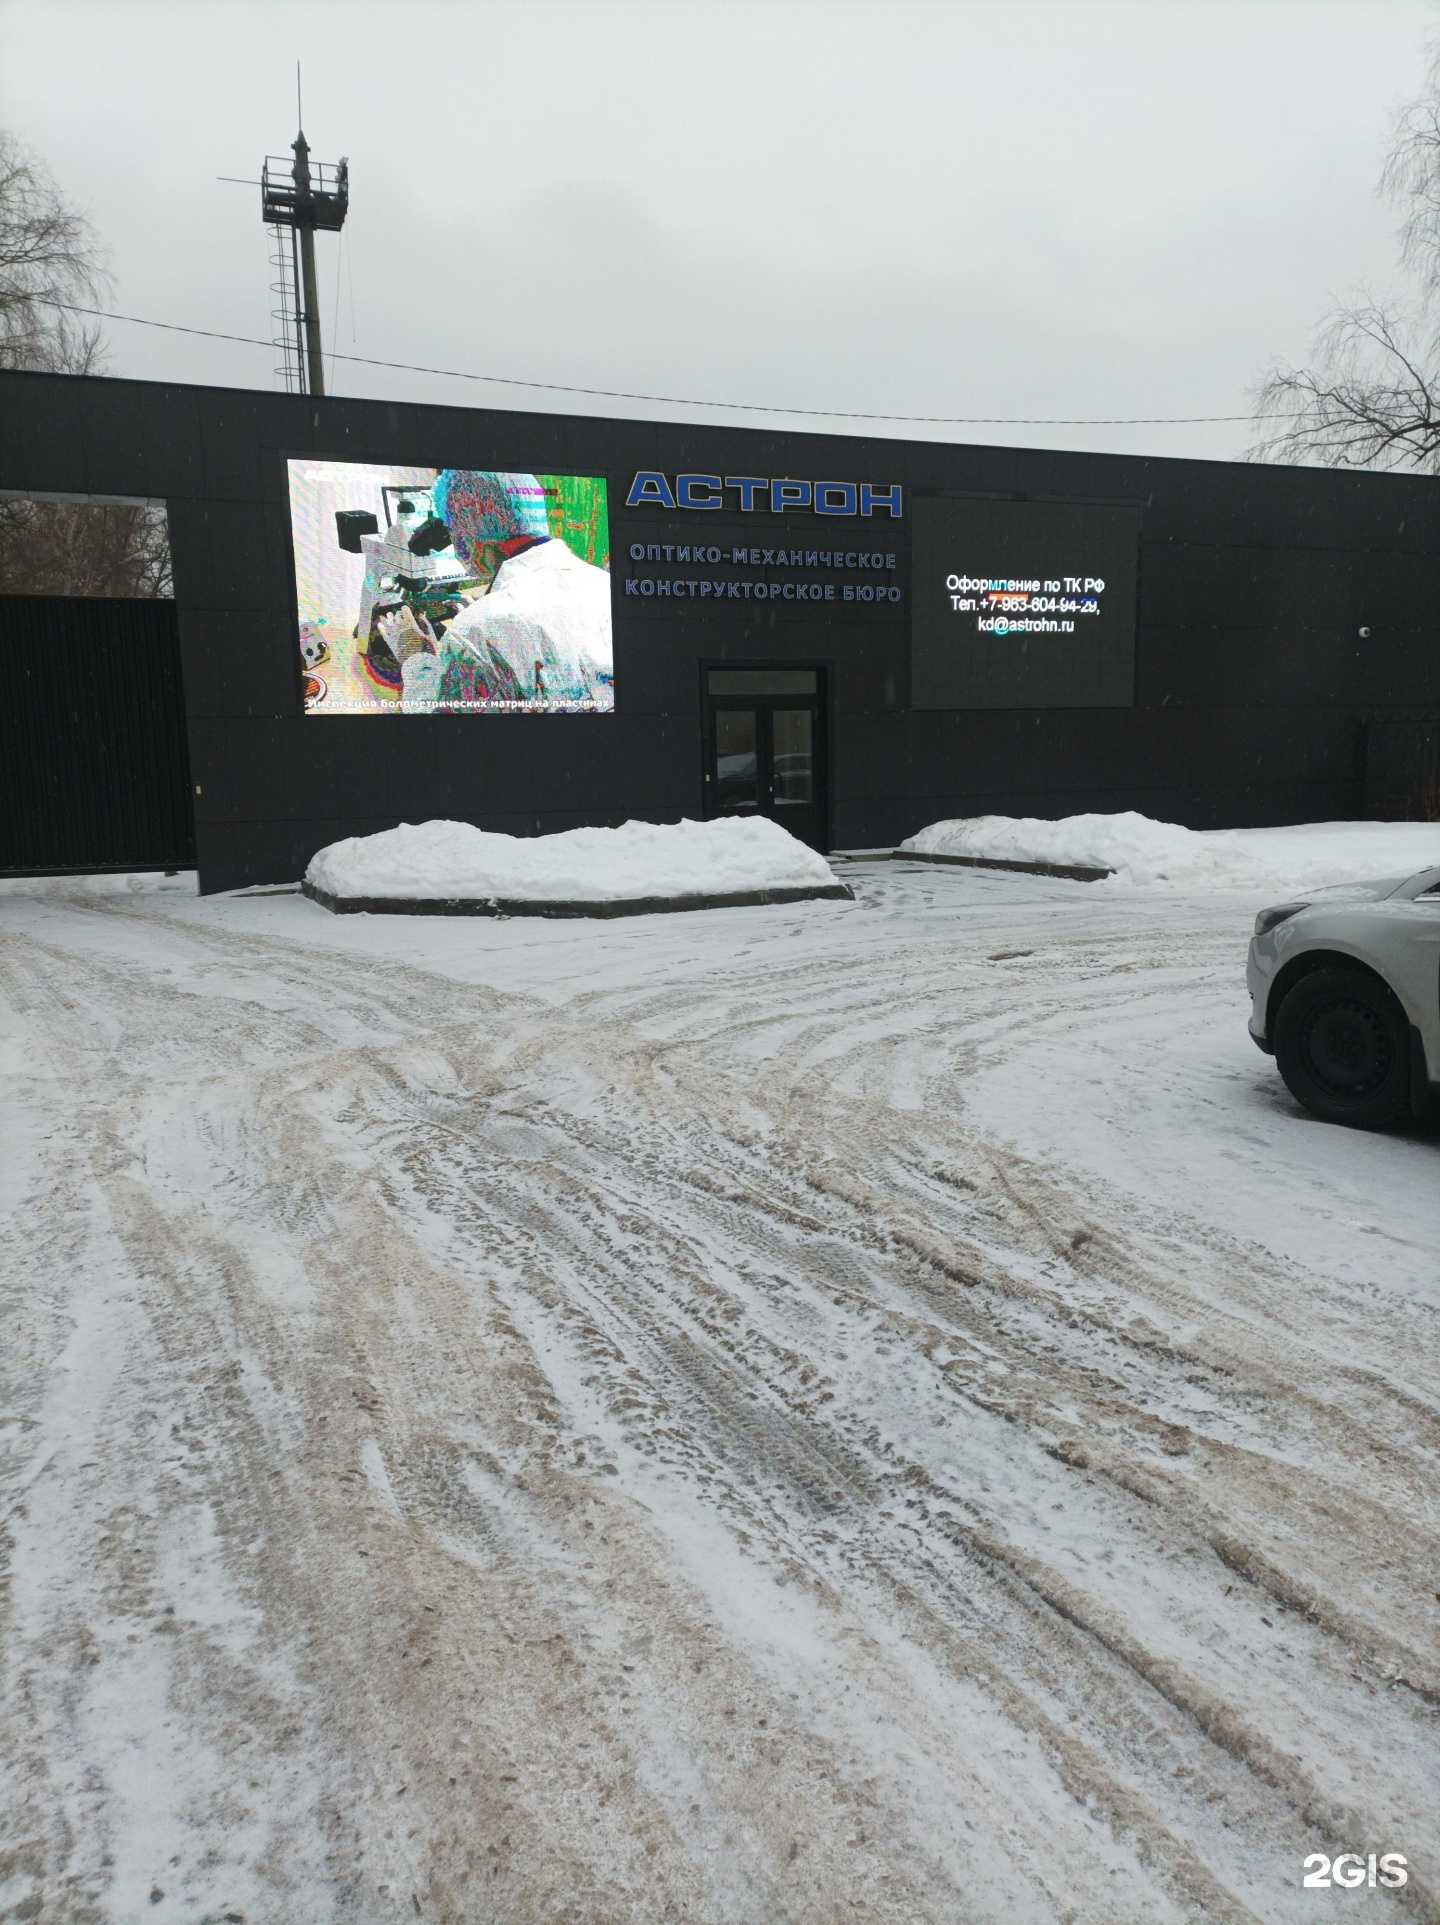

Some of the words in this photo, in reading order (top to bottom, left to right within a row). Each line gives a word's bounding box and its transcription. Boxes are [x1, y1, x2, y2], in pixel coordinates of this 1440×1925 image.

[625, 471, 903, 518] АСТРОН
[629, 543, 897, 570] ОПТИКО-МЕХАНИЧЕСКОЕ
[625, 578, 835, 601] КОНСТРУКТОРСКОЕ
[843, 585, 902, 602] БЮРО
[946, 574, 1041, 594] Оформление
[1044, 580, 1061, 593] по
[1063, 577, 1082, 593] ТК
[1084, 577, 1106, 593] РФ
[978, 615, 1075, 635] kd@astrohn.ru
[491, 699, 532, 709] матриц
[535, 699, 549, 708] на
